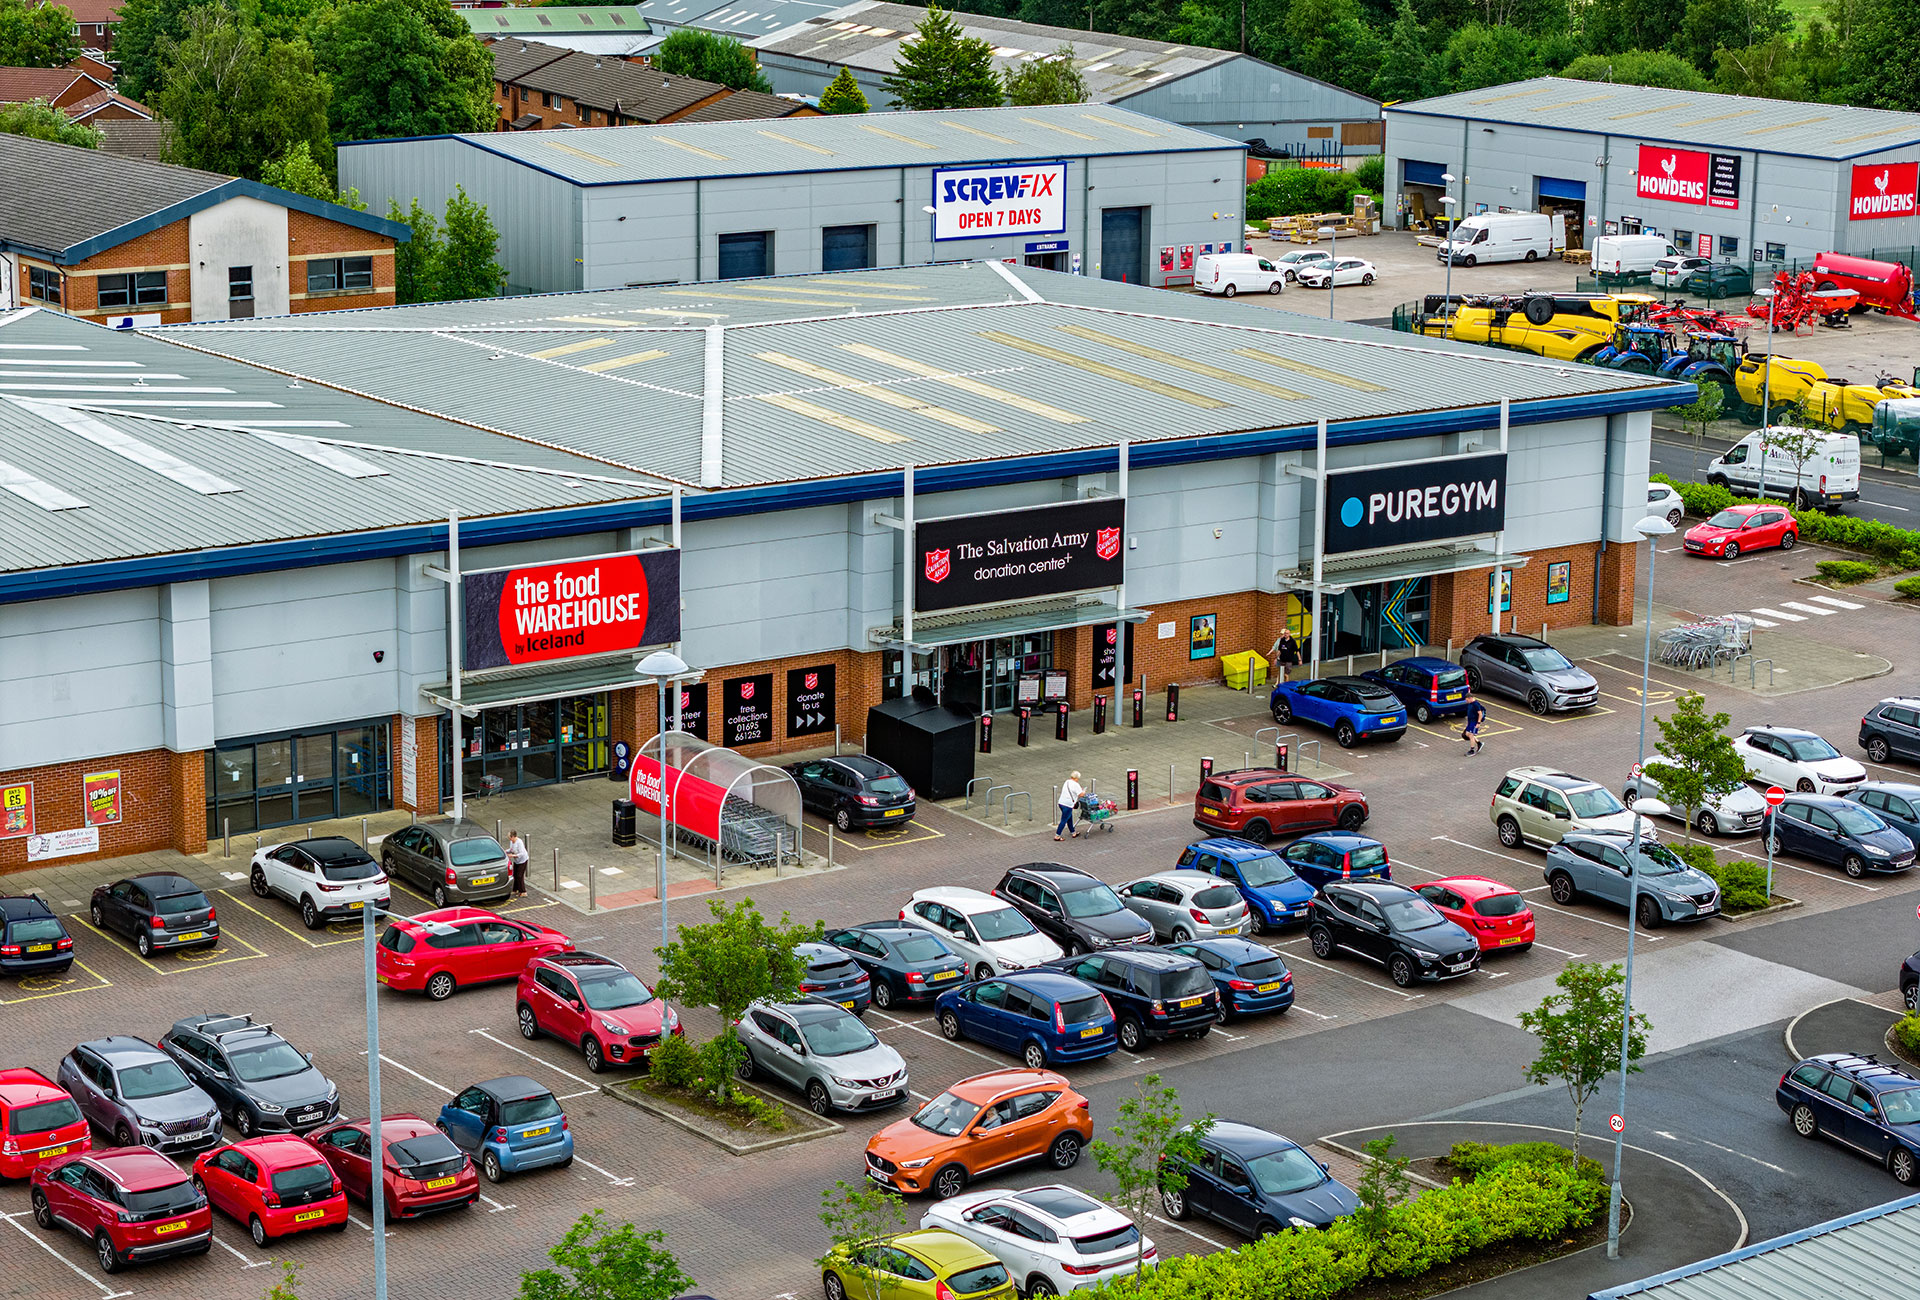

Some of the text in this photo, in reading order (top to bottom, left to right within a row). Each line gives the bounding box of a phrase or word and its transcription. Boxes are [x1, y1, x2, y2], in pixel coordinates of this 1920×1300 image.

[943, 173, 1057, 206] SCREWFIX
[1640, 176, 1704, 199] HOWDENS
[1853, 193, 1914, 214] HOWDENS
[959, 208, 1042, 230] OPEN 7 DAYS
[1368, 478, 1497, 525] PUREGYM
[957, 532, 1089, 560] The Salvation Army
[973, 562, 1026, 581] donation
[514, 567, 600, 606] the food
[515, 592, 640, 636] WAREHOUSE
[515, 630, 585, 656] by Iceland
[1103, 648, 1116, 656] sho
[797, 692, 825, 703] donate
[740, 705, 756, 713] free
[802, 703, 811, 711] to
[727, 713, 768, 725] collections
[736, 723, 759, 733] 01695
[735, 731, 761, 742] 661252
[636, 769, 647, 784] the
[10, 794, 21, 806] £5
[89, 787, 117, 801] 10% OFF
[1612, 1117, 1623, 1129] 20
